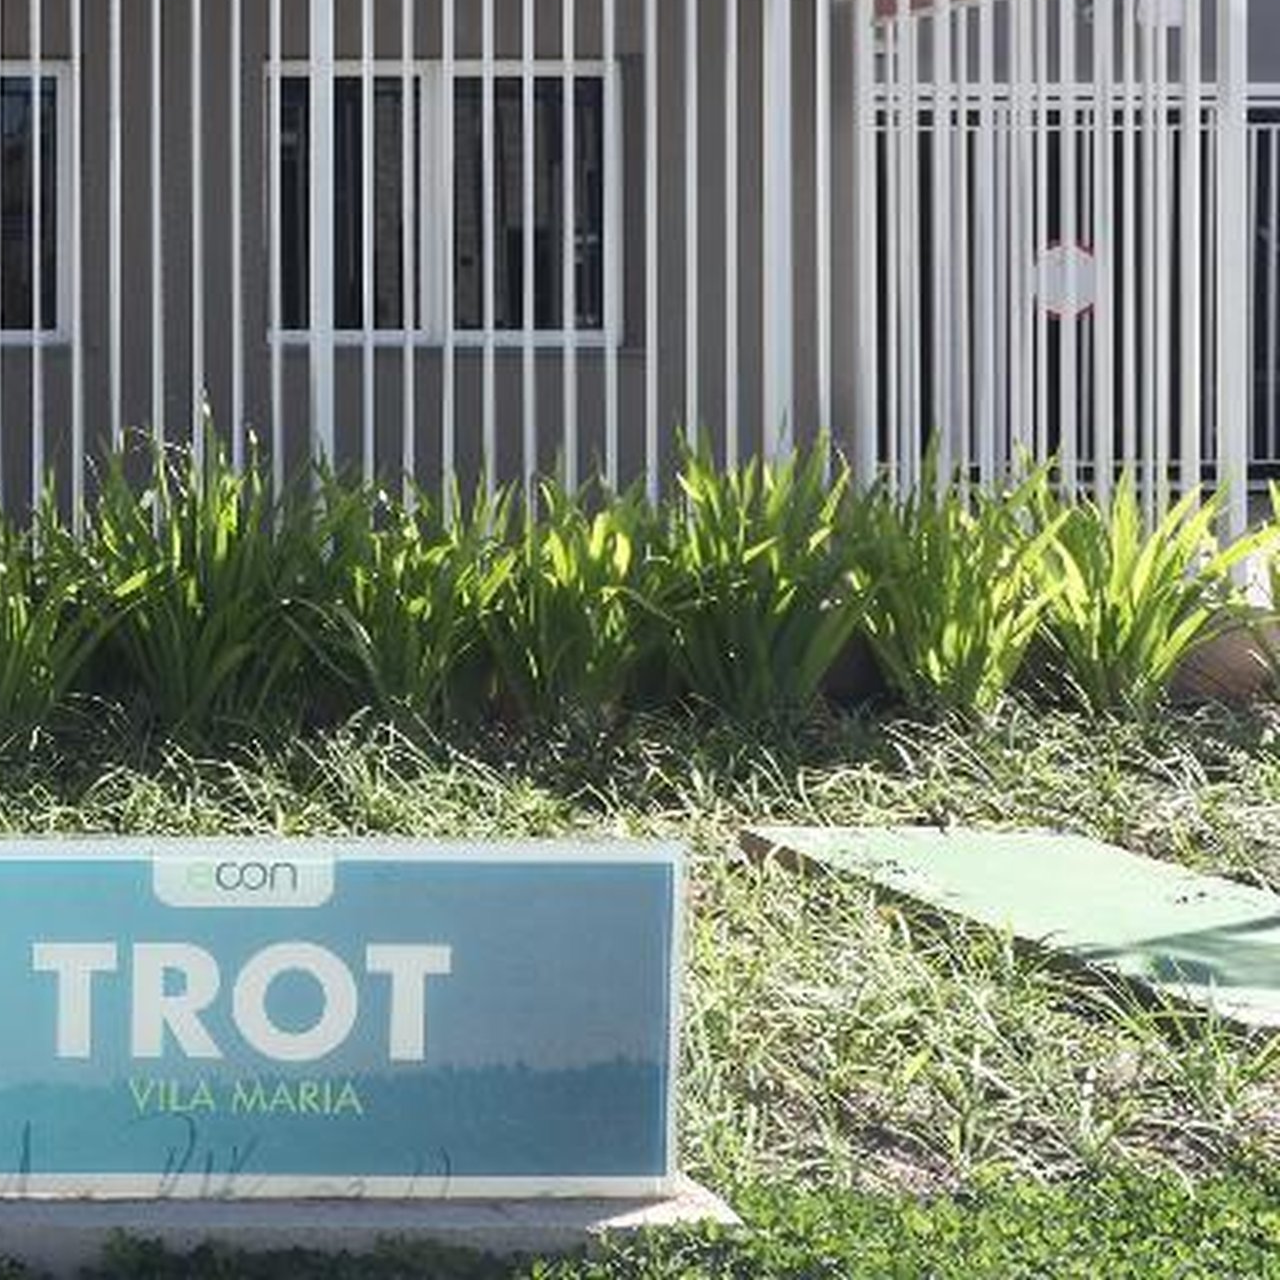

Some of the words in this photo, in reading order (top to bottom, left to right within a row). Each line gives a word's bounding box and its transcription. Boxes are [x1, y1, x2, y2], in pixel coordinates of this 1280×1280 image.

[32, 941, 452, 1062] TROT
[129, 1079, 216, 1112] VILA
[232, 1079, 364, 1115] MARIA
